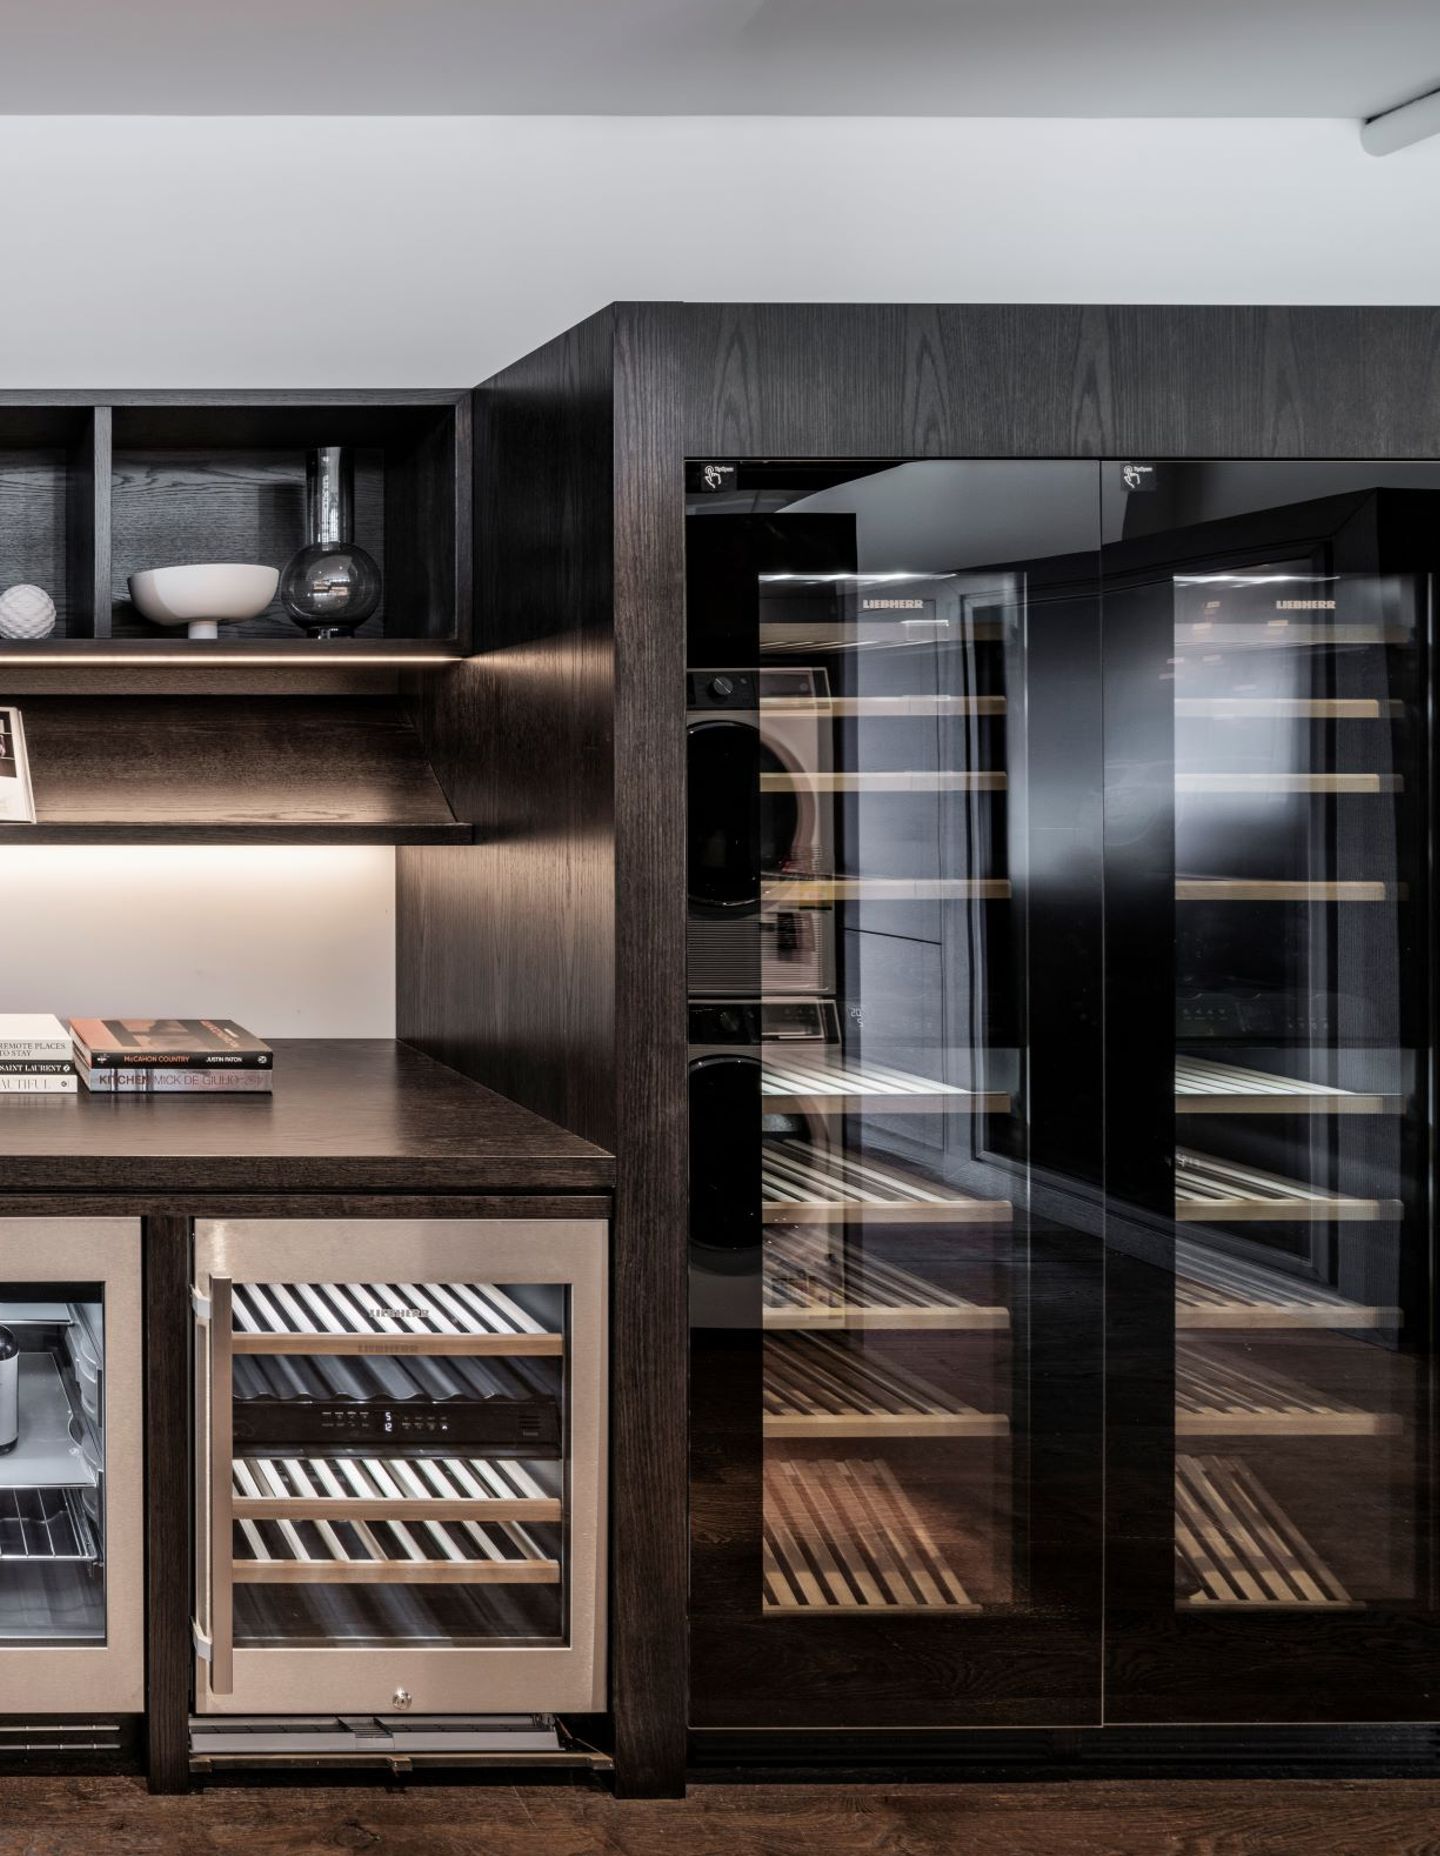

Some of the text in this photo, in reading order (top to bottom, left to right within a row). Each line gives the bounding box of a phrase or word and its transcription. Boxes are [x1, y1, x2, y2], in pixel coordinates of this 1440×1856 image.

[862, 599, 924, 609] LIEBHERR
[1275, 600, 1337, 609] LIEBHERR
[34, 1042, 66, 1050] PLACES
[0, 1064, 23, 1072] SAINT
[24, 1064, 62, 1072] LAURENT
[99, 1075, 149, 1085] KITCHEN
[152, 1075, 182, 1085] MICK
[183, 1075, 200, 1085] DE
[368, 1308, 430, 1318] LIEBHERR
